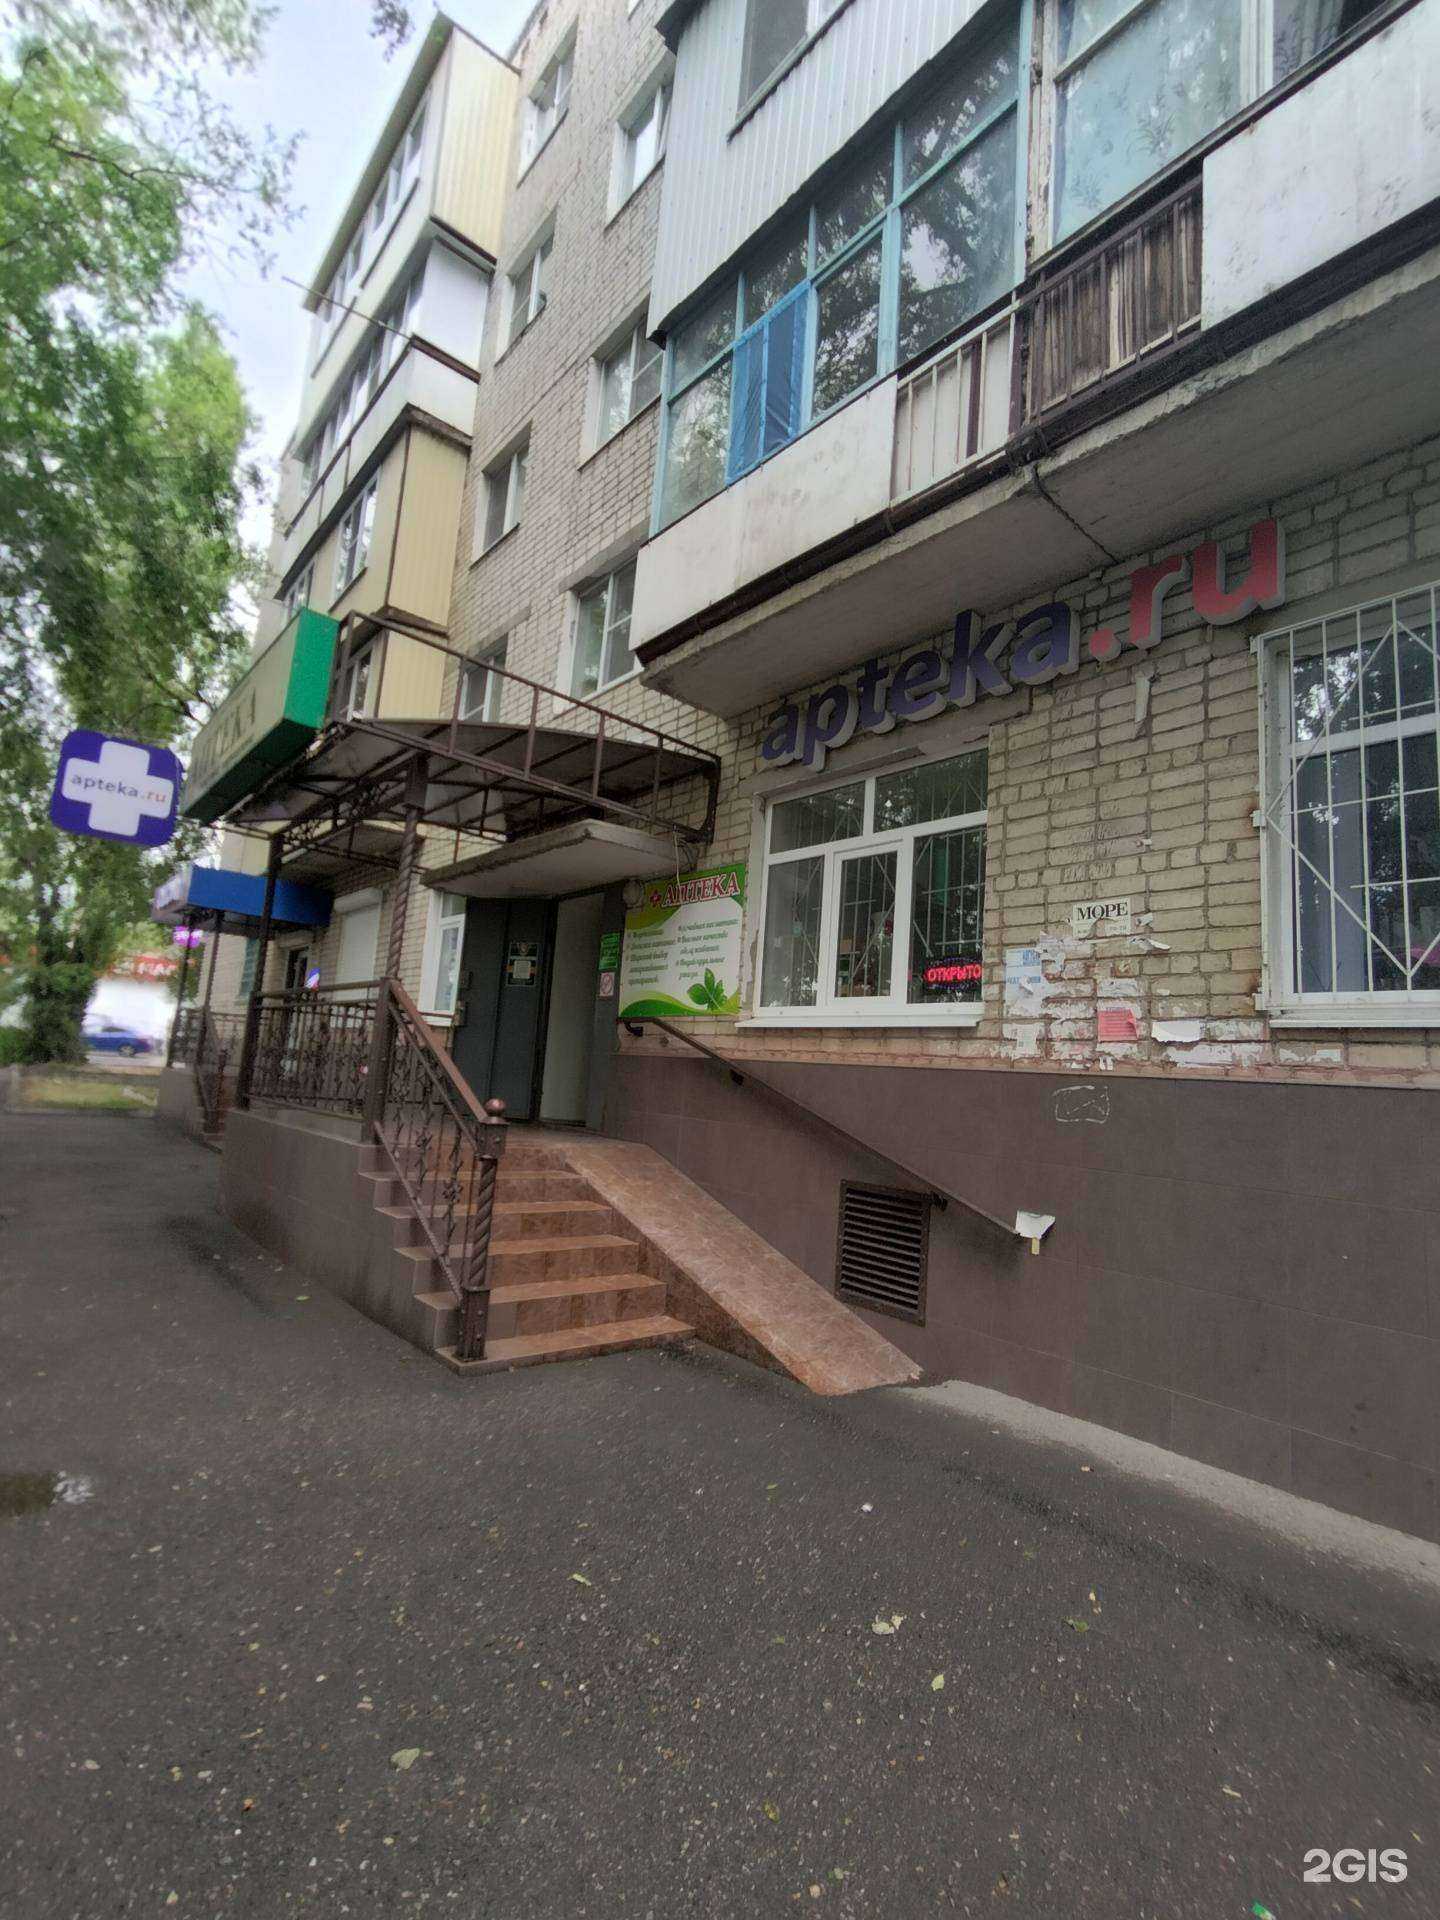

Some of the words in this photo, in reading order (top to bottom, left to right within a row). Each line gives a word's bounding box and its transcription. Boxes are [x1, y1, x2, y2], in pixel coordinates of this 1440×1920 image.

[760, 518, 1285, 772] apteka.ru
[71, 774, 167, 803] apteka.ru
[662, 872, 740, 907] АПТЕКА
[1077, 902, 1128, 920] МОРЕ
[928, 963, 982, 982] ОТКРЫТО
